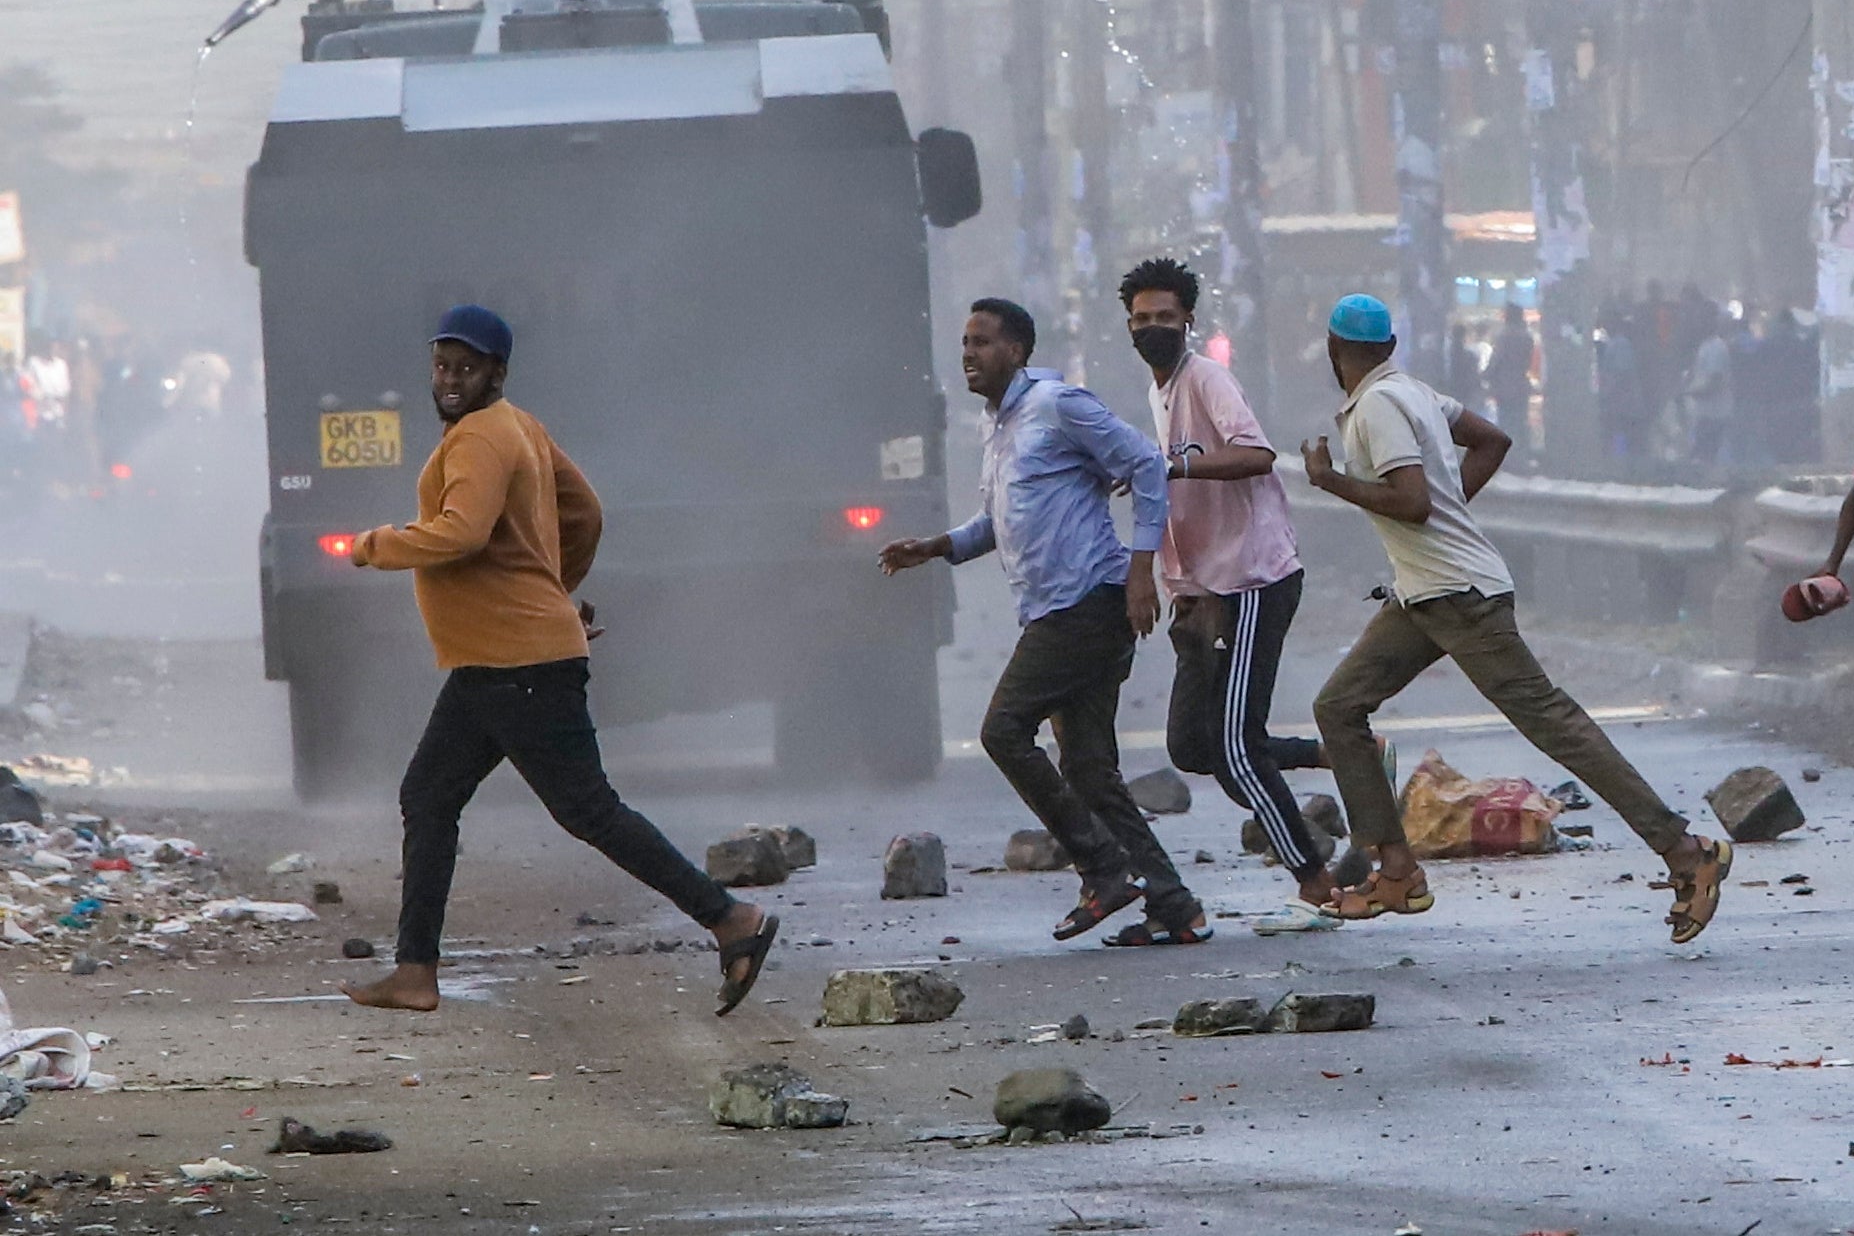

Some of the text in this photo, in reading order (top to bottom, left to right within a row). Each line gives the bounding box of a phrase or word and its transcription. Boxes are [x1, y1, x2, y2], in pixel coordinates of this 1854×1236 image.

[327, 416, 377, 440] GKB
[327, 440, 396, 463] 605U
[281, 474, 312, 491] GSU
